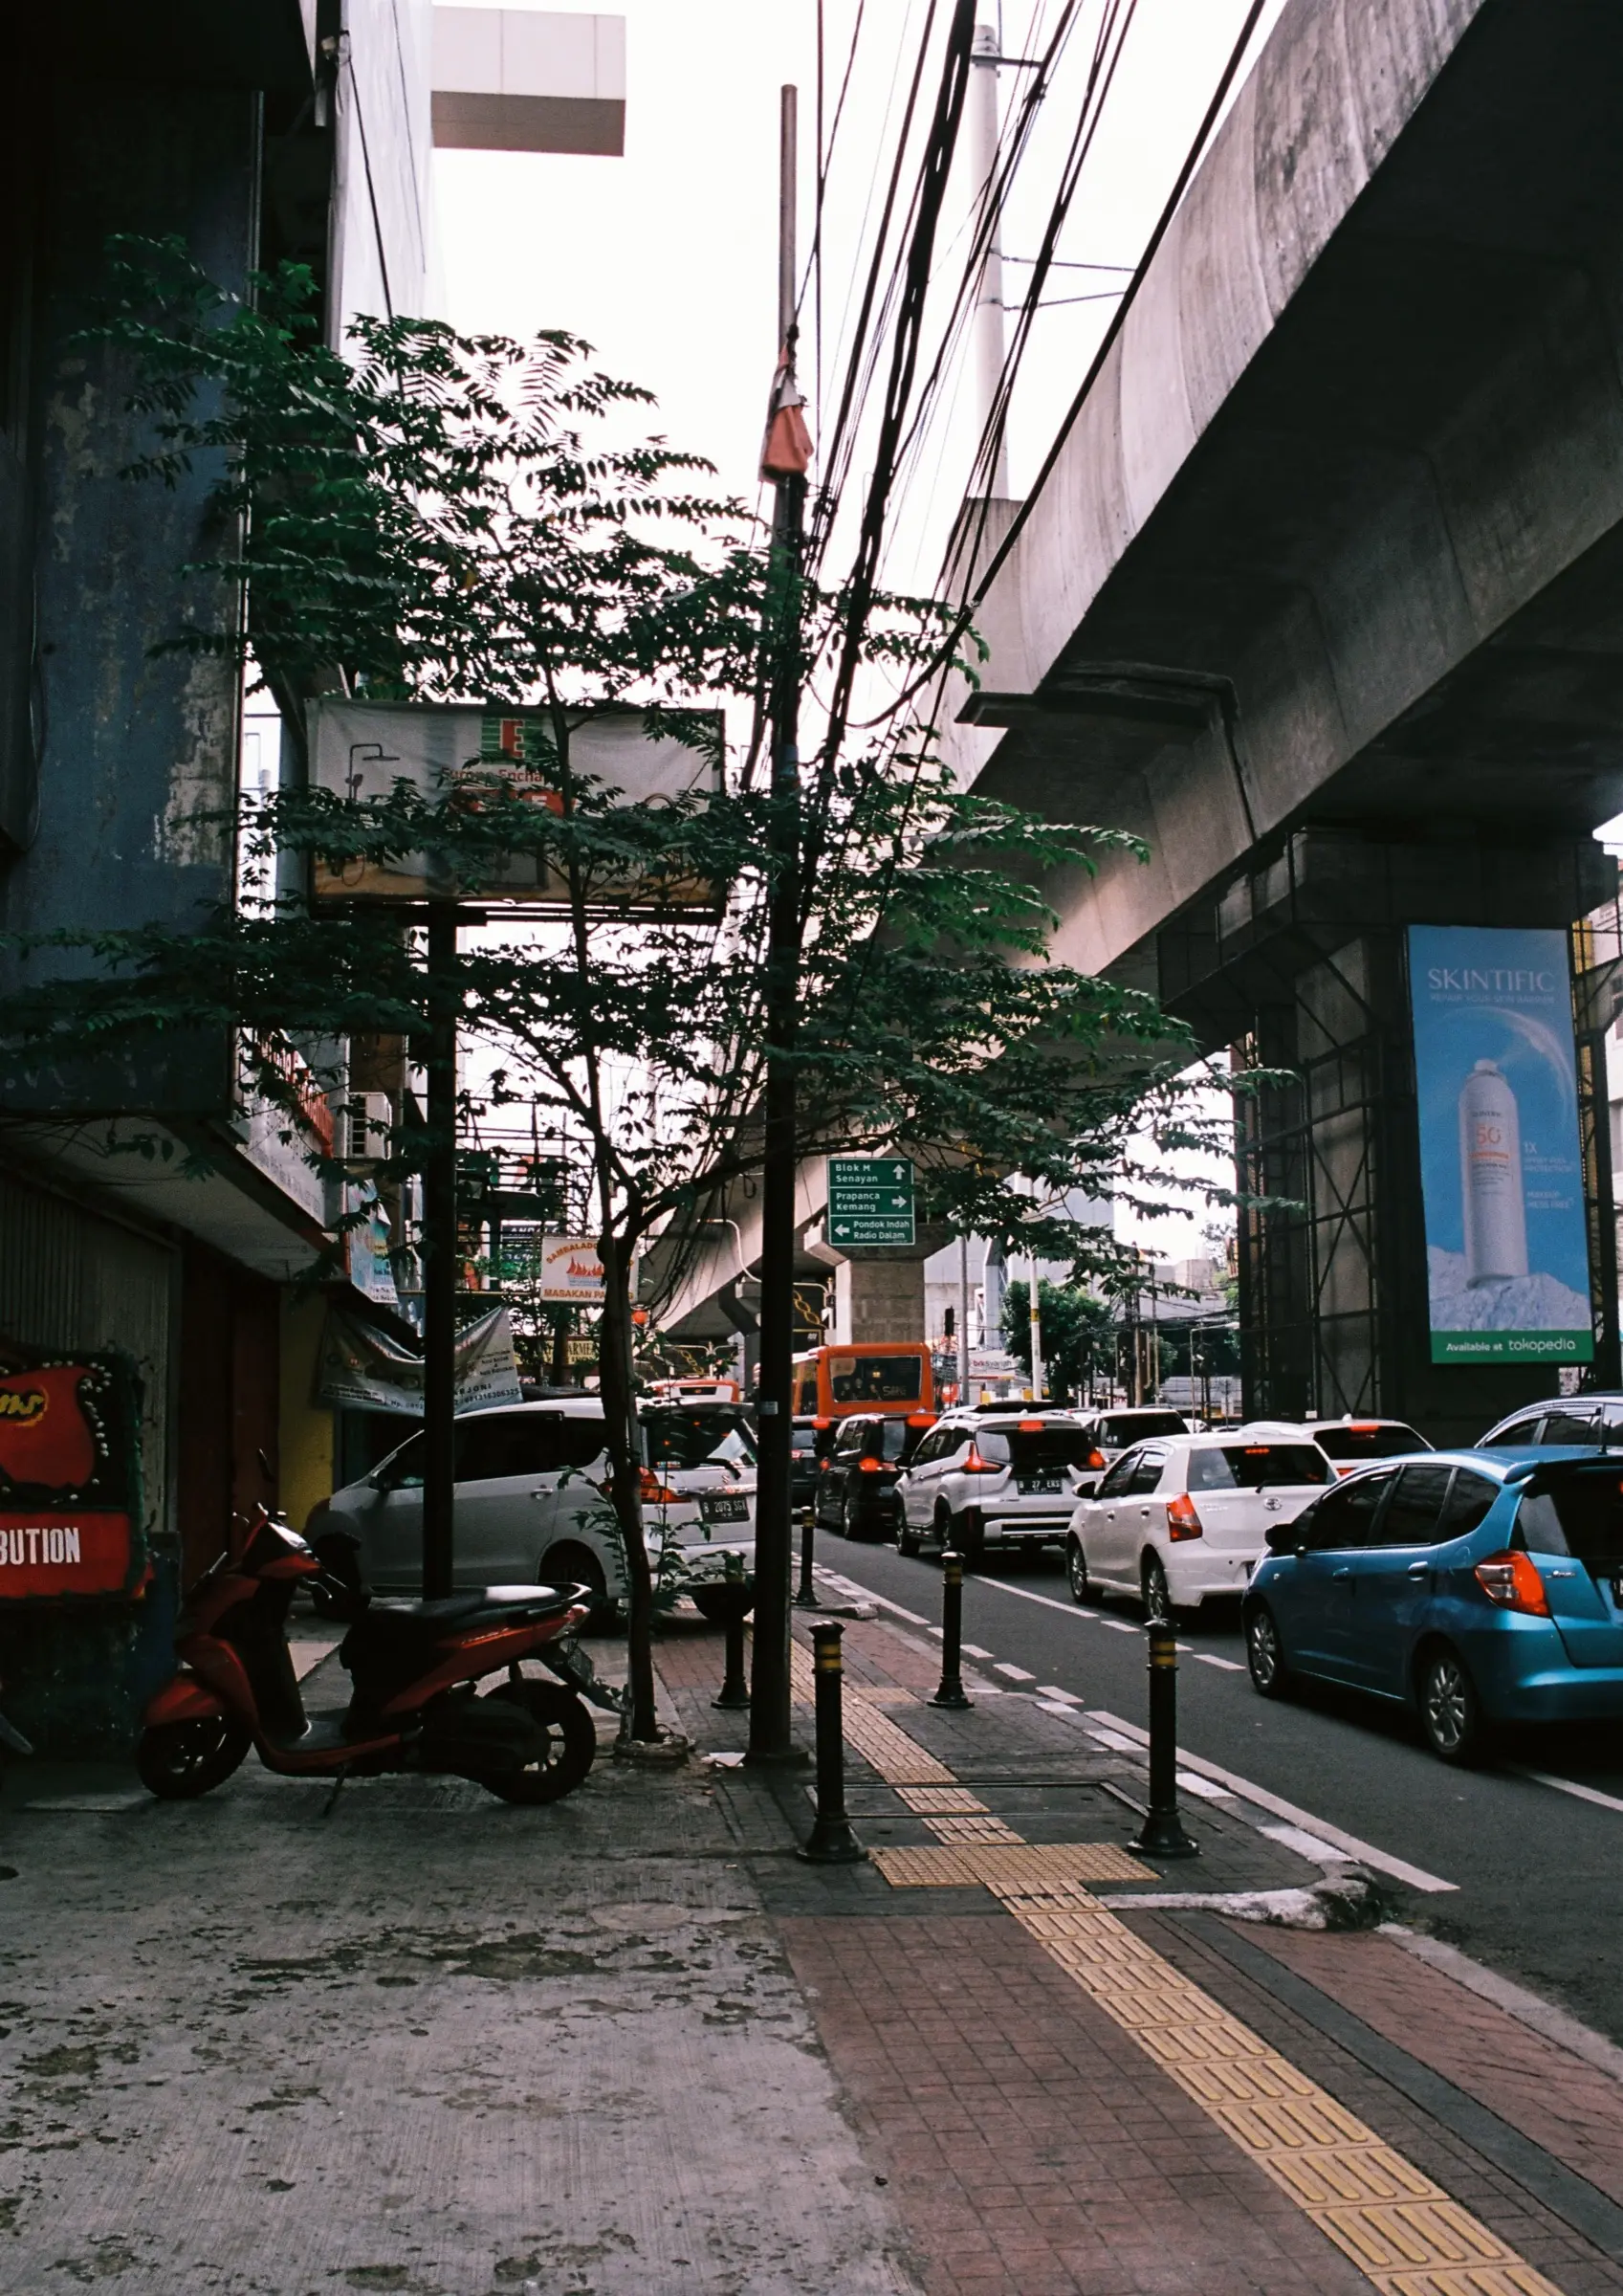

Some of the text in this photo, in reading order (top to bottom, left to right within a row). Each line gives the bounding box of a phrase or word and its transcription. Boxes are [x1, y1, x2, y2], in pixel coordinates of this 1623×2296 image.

[1428, 968, 1555, 992] SKINTIFIC
[835, 1163, 860, 1172] Blok
[835, 1175, 878, 1184] Senayan
[836, 1192, 880, 1202] Prapanca
[836, 1203, 876, 1213] Kemang
[853, 1220, 910, 1228] Pondok Indah
[853, 1231, 906, 1240] Radio Dalam
[544, 1289, 592, 1299] MASAKAN
[1446, 1342, 1490, 1352] Available
[1508, 1337, 1577, 1354] tokopedia
[0, 1527, 80, 1565] BUTION
